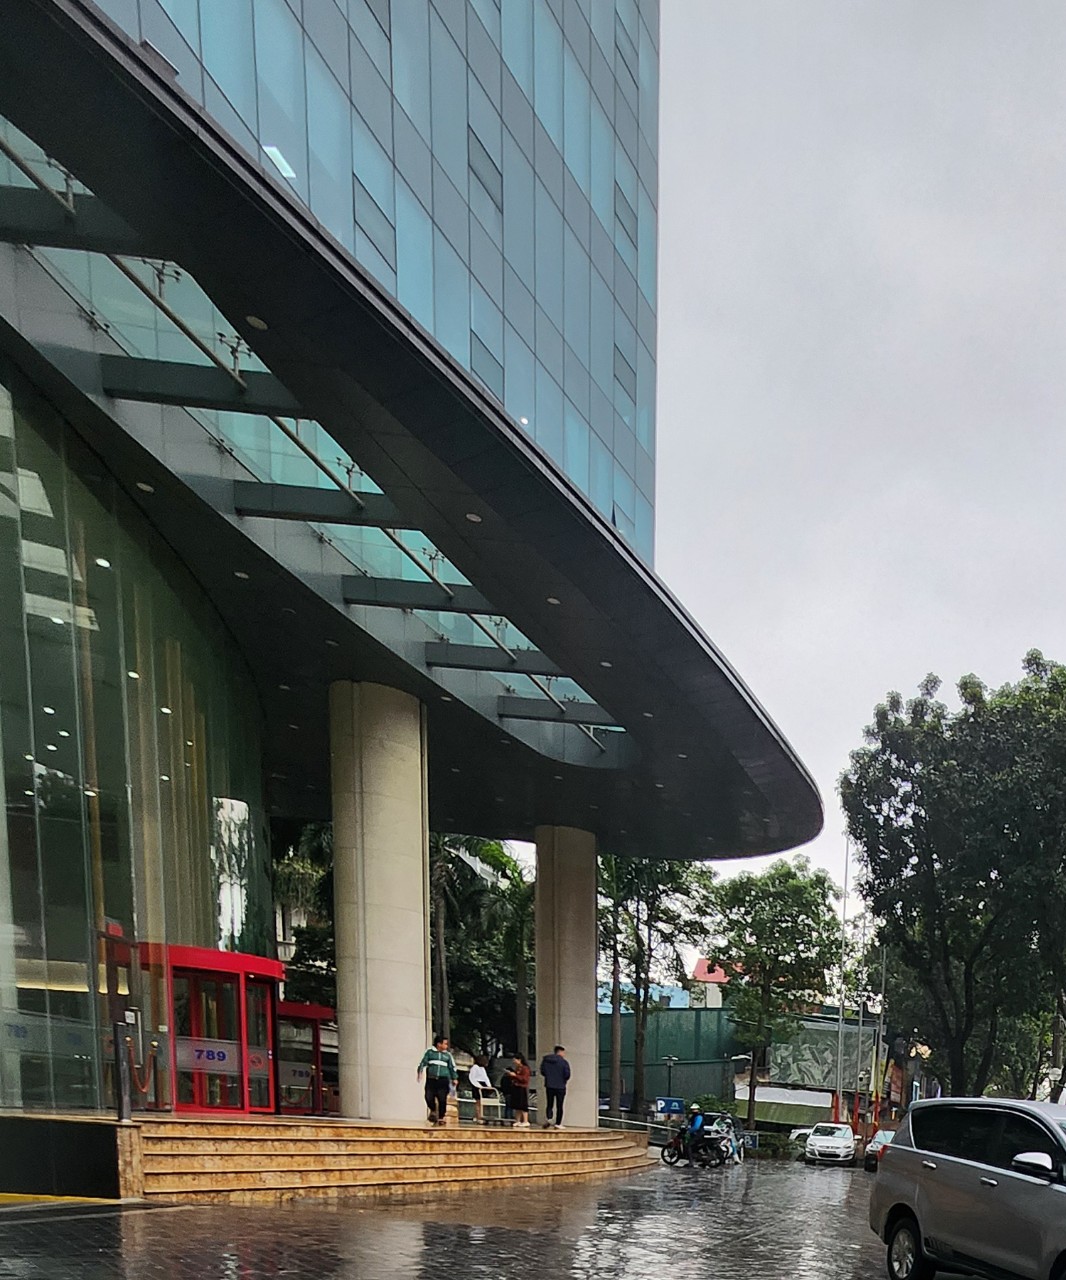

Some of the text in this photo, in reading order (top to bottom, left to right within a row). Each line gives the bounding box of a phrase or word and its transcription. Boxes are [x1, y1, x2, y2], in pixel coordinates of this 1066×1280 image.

[194, 1049, 226, 1061] 789
[291, 1069, 310, 1078] 789
[657, 1100, 665, 1111] P
